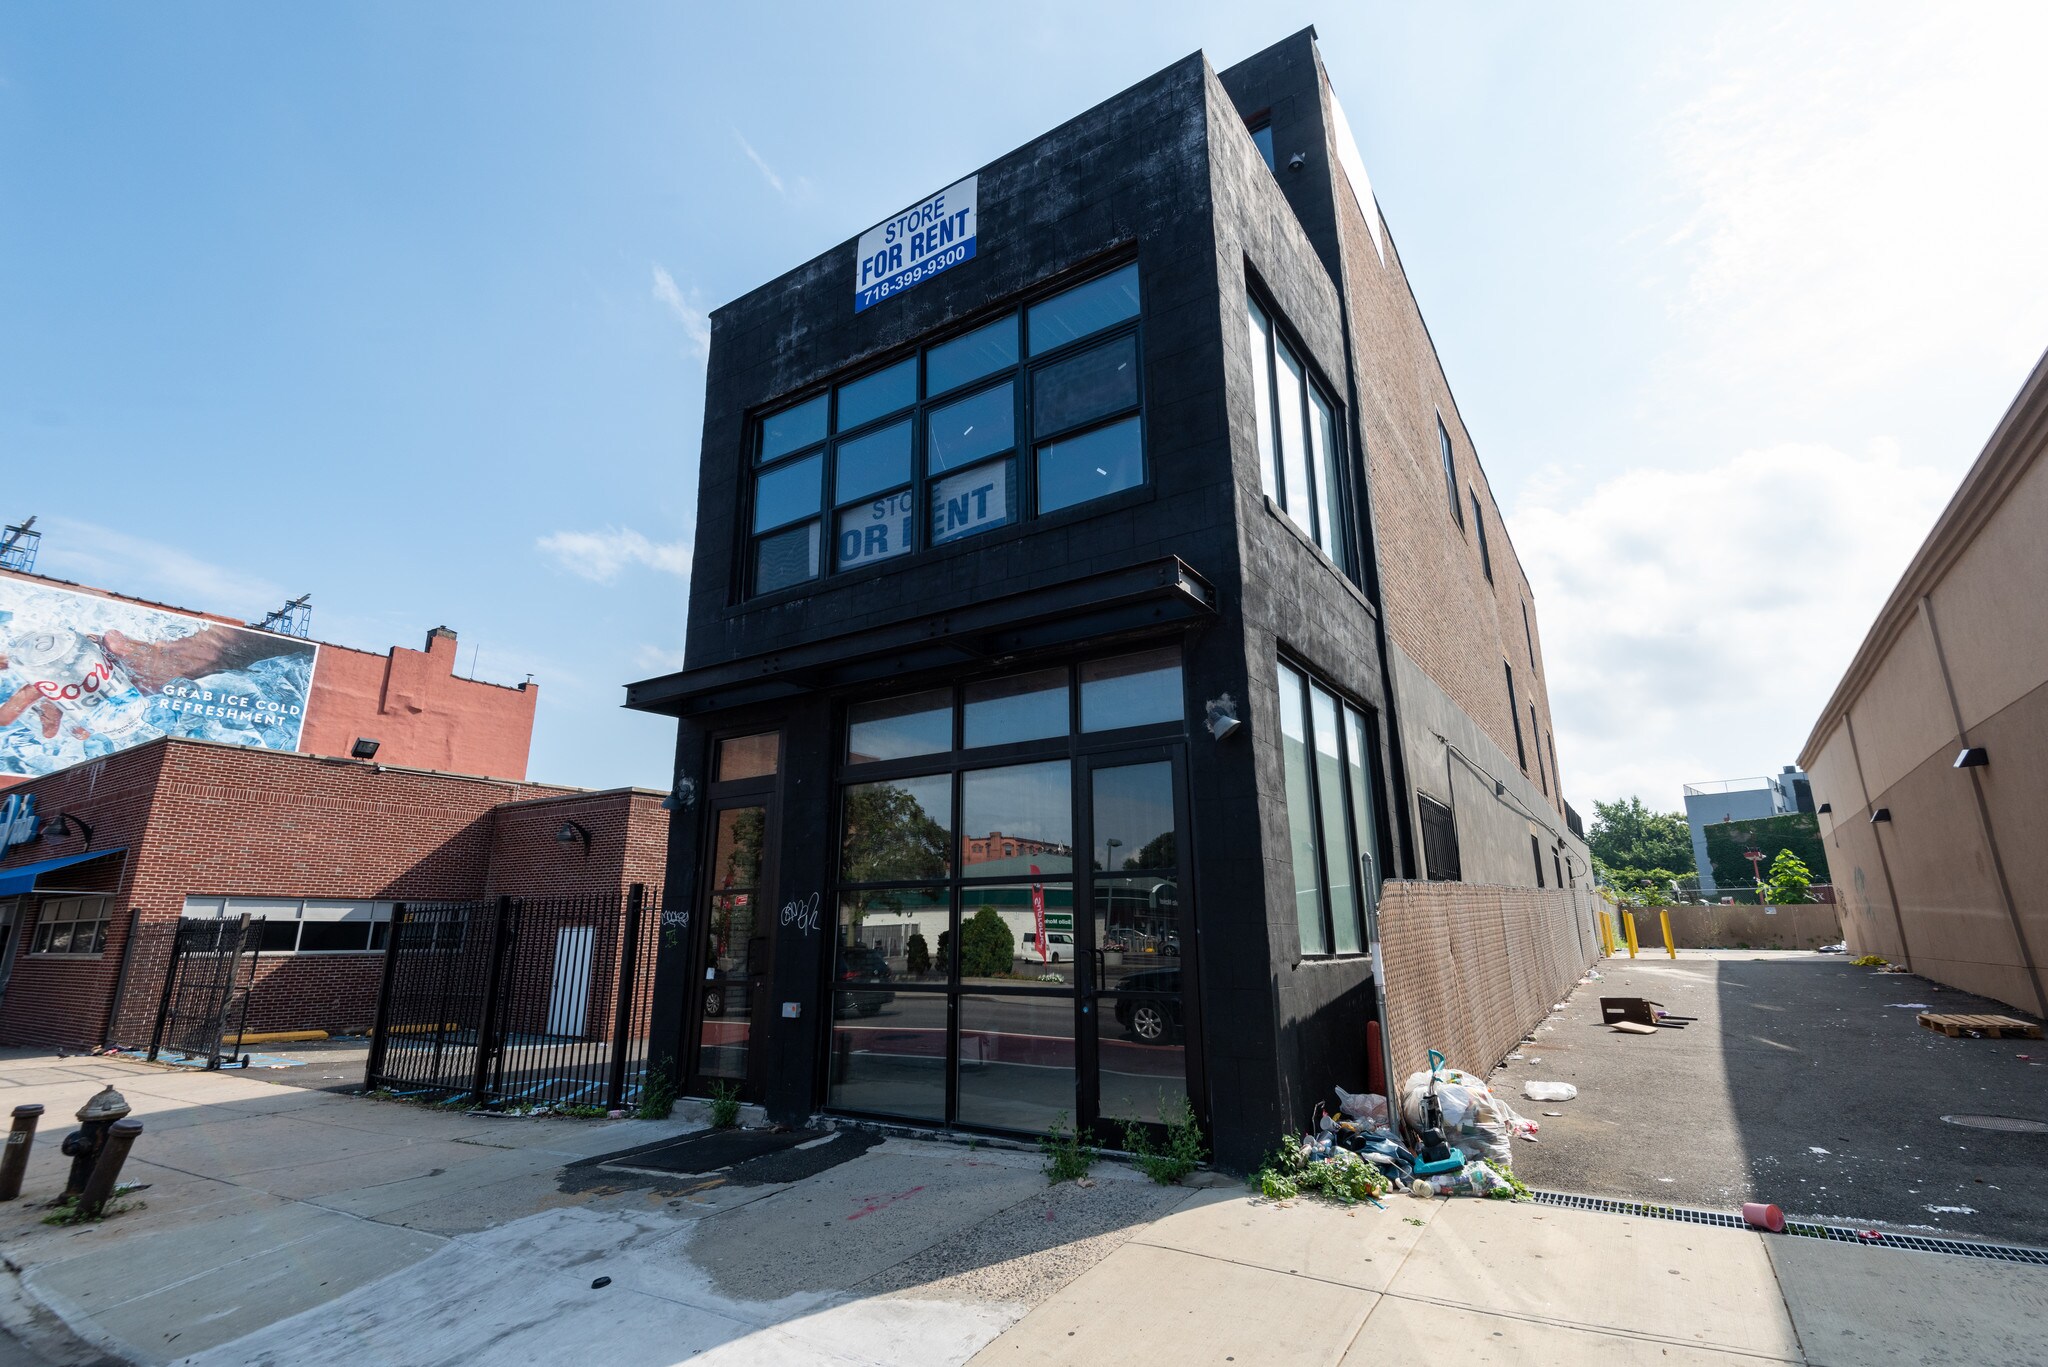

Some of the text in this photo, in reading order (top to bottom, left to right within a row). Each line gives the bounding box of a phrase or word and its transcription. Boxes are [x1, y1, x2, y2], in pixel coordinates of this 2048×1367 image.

[885, 195, 945, 244] STORE
[862, 207, 970, 286] FOR RENT
[864, 245, 966, 306] 718-399-9300
[57, 670, 123, 711] LIGHT
[159, 698, 286, 726] REFRESHMENT
[162, 684, 300, 715] GRAB ICE COLD
